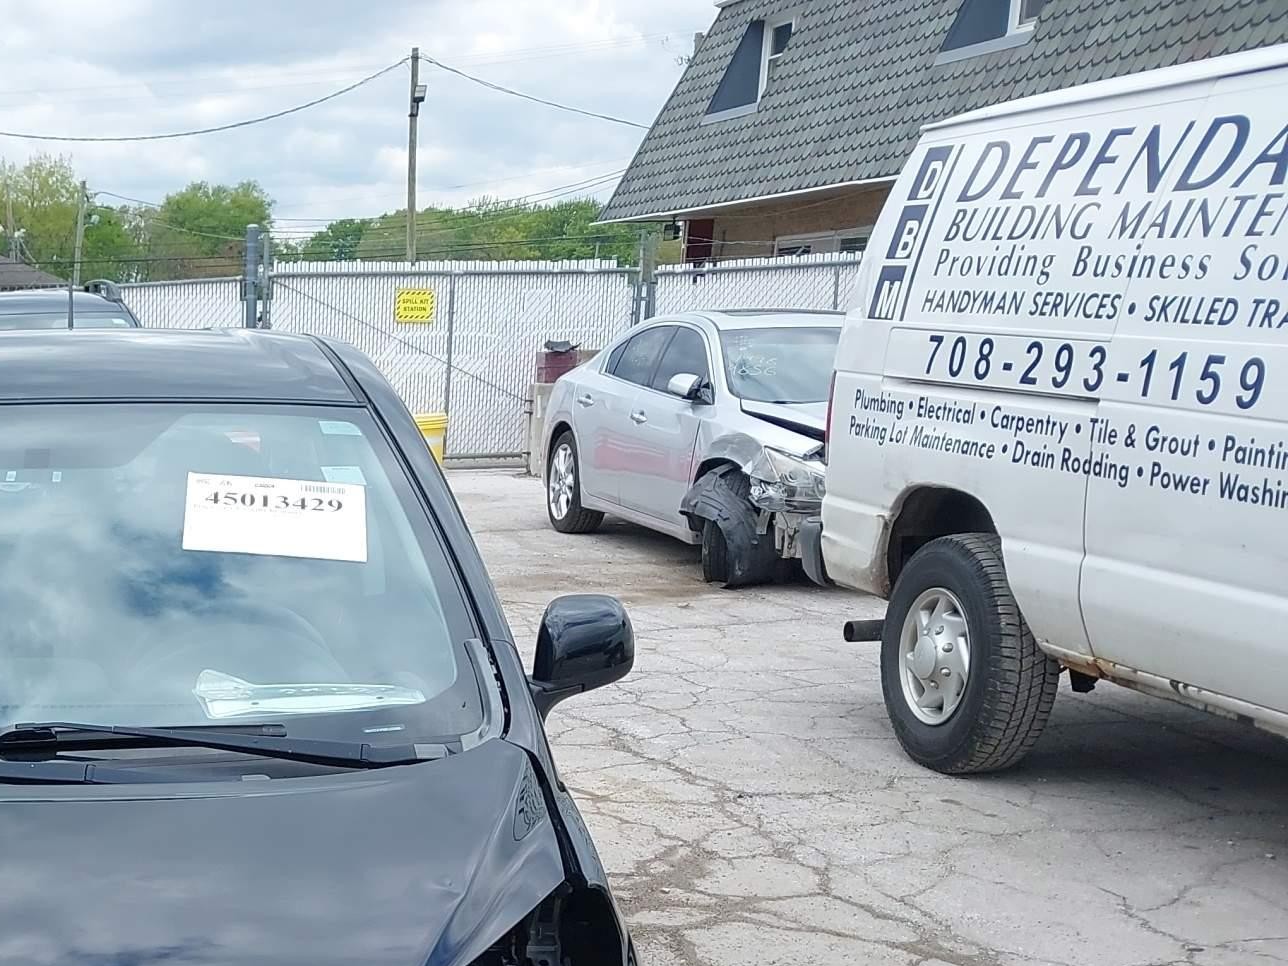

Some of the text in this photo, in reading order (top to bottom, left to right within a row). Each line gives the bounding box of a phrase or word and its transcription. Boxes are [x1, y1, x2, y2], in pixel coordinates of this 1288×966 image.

[943, 202, 1102, 242] BUILDING
[933, 244, 1056, 285] Providing
[1072, 243, 1212, 280] Business
[921, 290, 1025, 316] HANDYMAN
[1028, 291, 1122, 320] SERVICES
[1143, 294, 1239, 326] SKILLED
[925, 334, 1265, 410] 708-293-1159
[854, 388, 905, 421] Plumbing
[916, 396, 977, 425] Electrical
[990, 405, 1069, 444] Carpentry
[1089, 417, 1118, 446] Tile
[1124, 423, 1137, 449] &
[1145, 425, 1201, 458] Grout
[849, 415, 887, 446] Parking
[888, 421, 909, 445] Lot
[909, 424, 996, 460] Maintenance
[1011, 440, 1056, 470] Drain
[1060, 446, 1130, 488] Rodding
[1149, 461, 1211, 496] Power
[204, 490, 344, 513] 45013429
